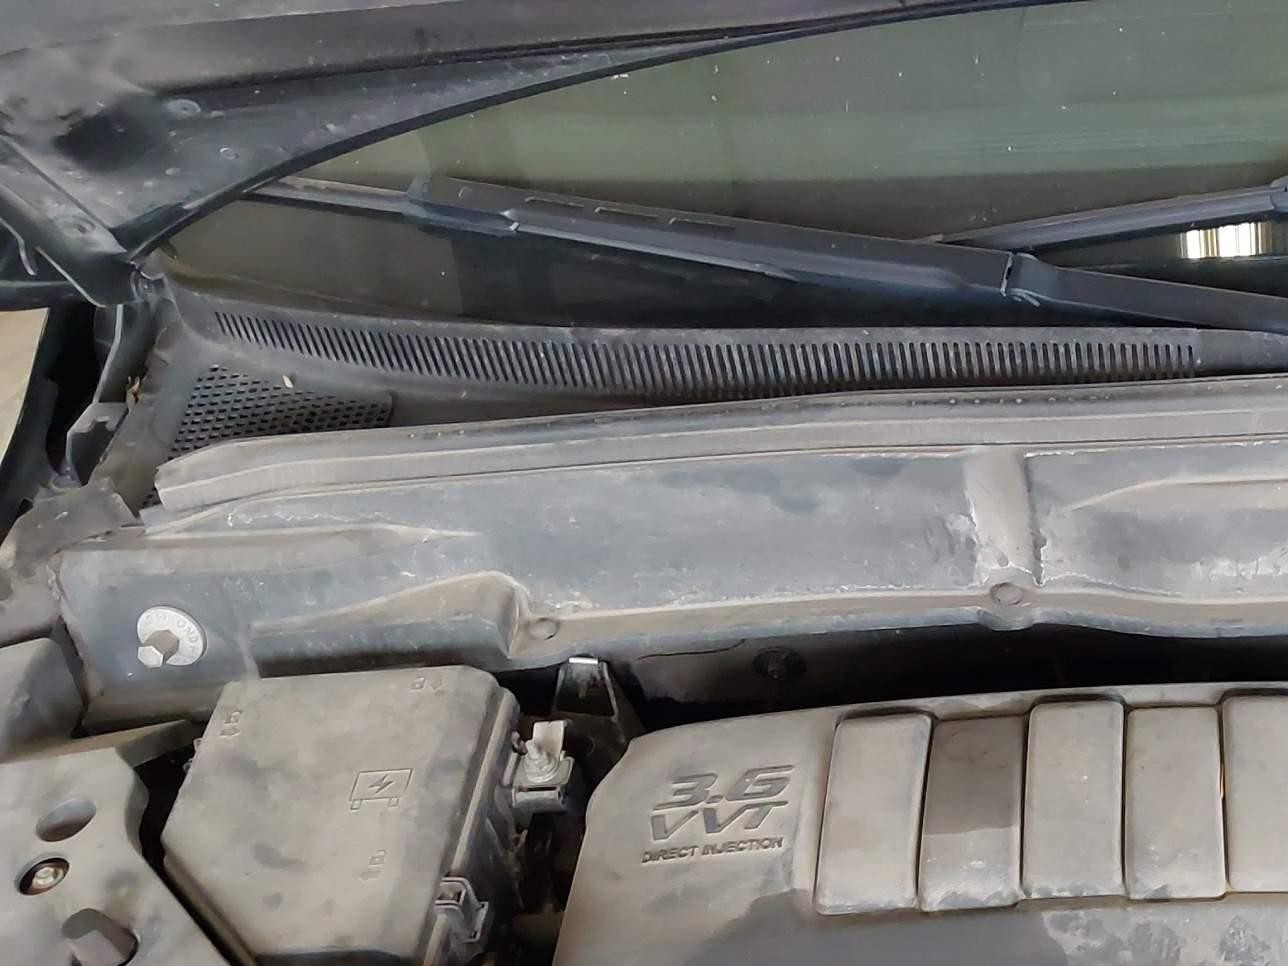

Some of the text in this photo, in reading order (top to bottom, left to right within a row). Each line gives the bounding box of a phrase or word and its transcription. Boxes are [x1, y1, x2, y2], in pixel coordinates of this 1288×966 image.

[652, 764, 795, 812] 3.6
[649, 801, 790, 842] VVT
[641, 836, 784, 865] DIRECT INJECTION
